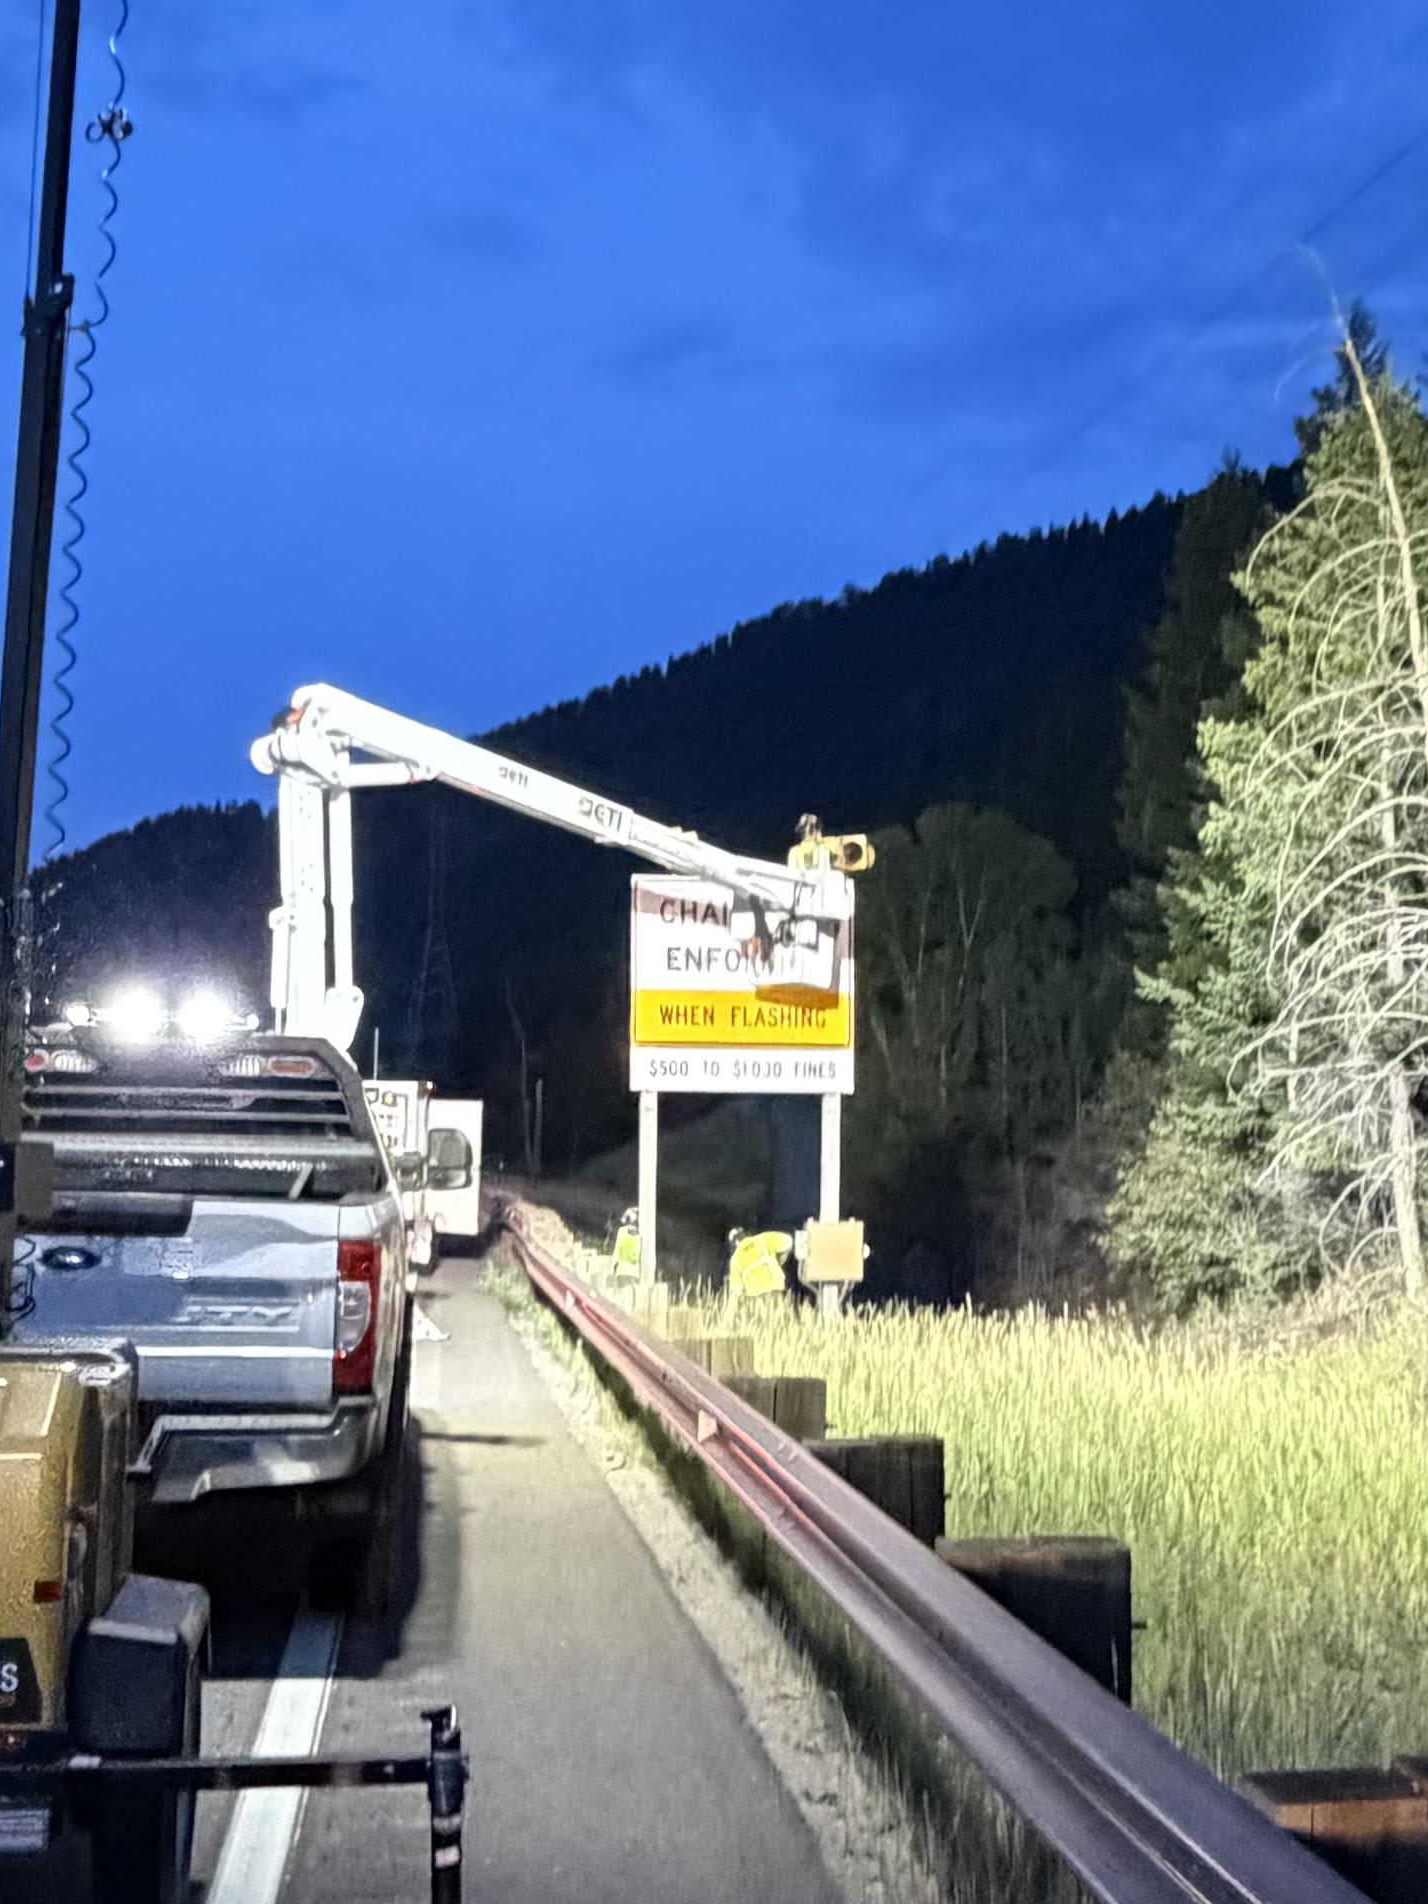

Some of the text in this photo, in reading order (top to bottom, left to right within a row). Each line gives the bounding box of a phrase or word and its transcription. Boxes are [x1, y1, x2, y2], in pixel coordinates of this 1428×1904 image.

[659, 897, 728, 928] CHAI
[666, 946, 745, 973] ENFO
[659, 1003, 827, 1030] WHEN FLASHING
[649, 1058, 689, 1078] $500
